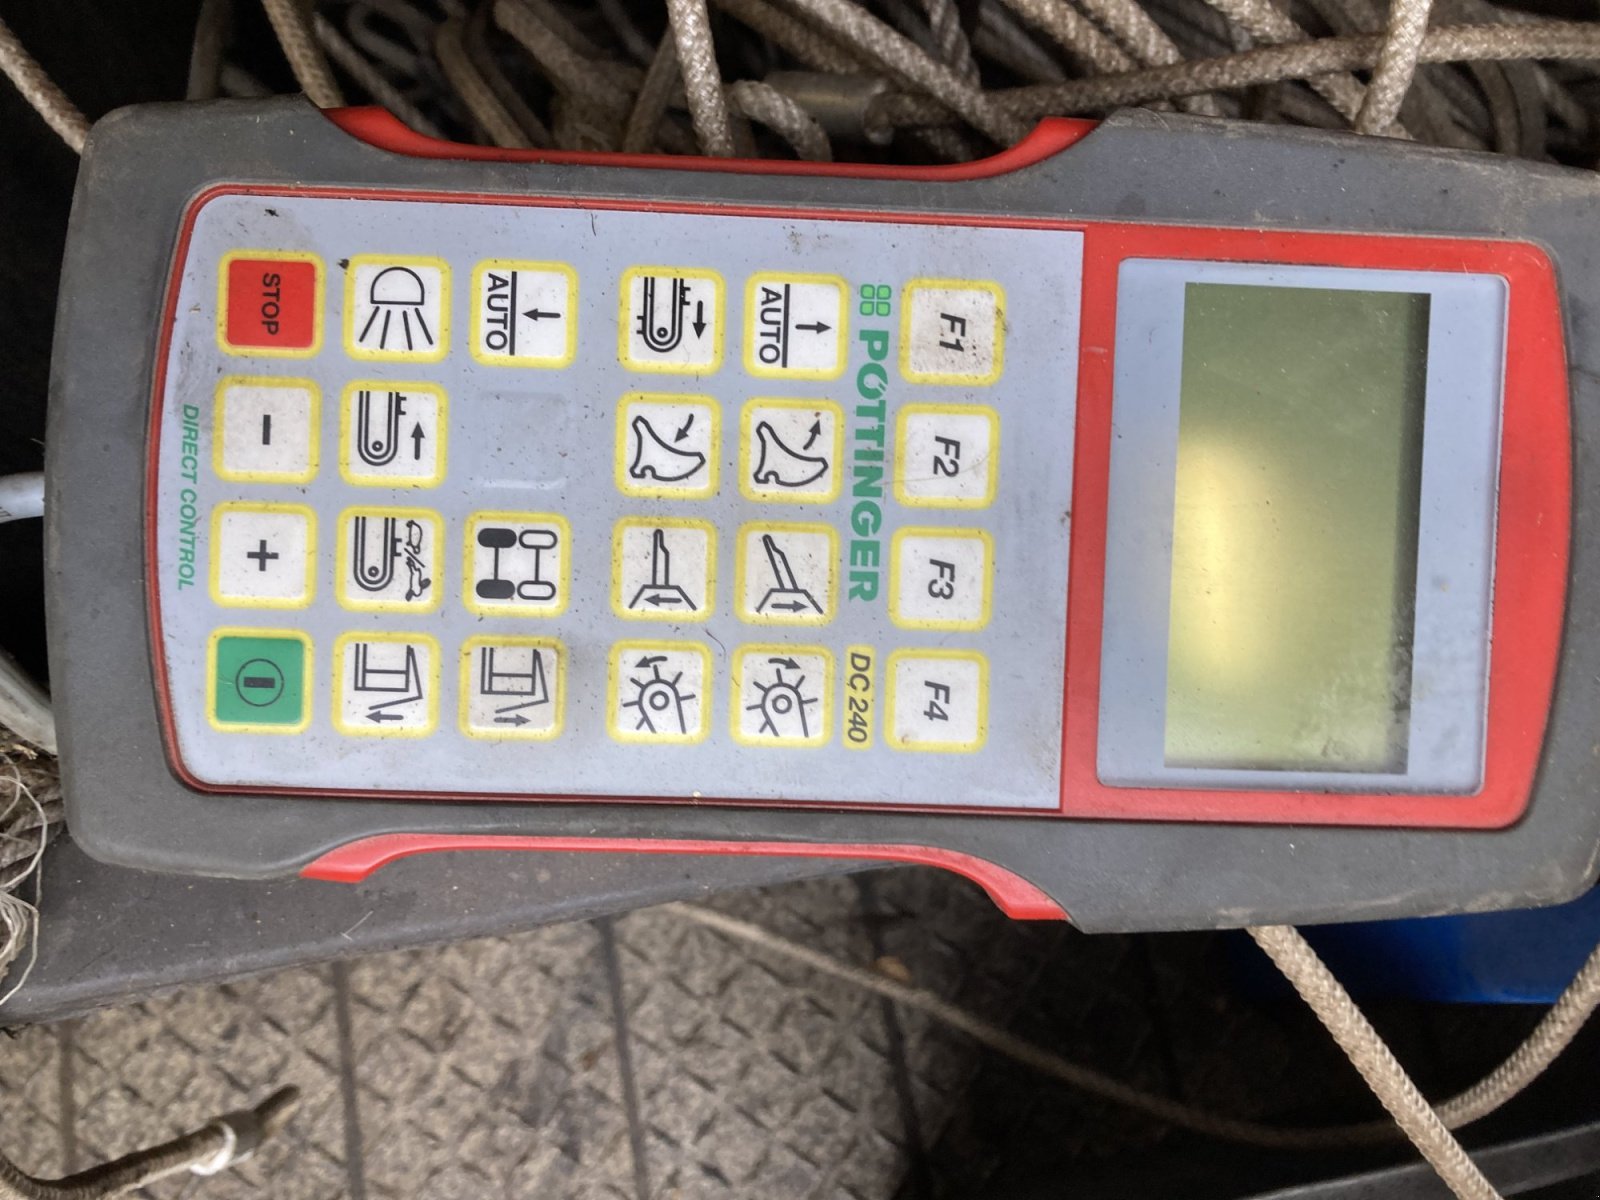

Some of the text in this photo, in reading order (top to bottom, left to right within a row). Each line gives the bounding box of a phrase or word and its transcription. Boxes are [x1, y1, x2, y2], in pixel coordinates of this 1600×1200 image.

[261, 272, 281, 335] STOP
[486, 273, 510, 351] AUTO
[759, 286, 783, 364] AUTO
[939, 313, 966, 353] F1
[933, 436, 961, 477] F2
[177, 403, 199, 591] DIRECT CONTROL
[928, 559, 955, 600] F3
[846, 653, 871, 743] DC 240
[923, 681, 950, 722] F4
